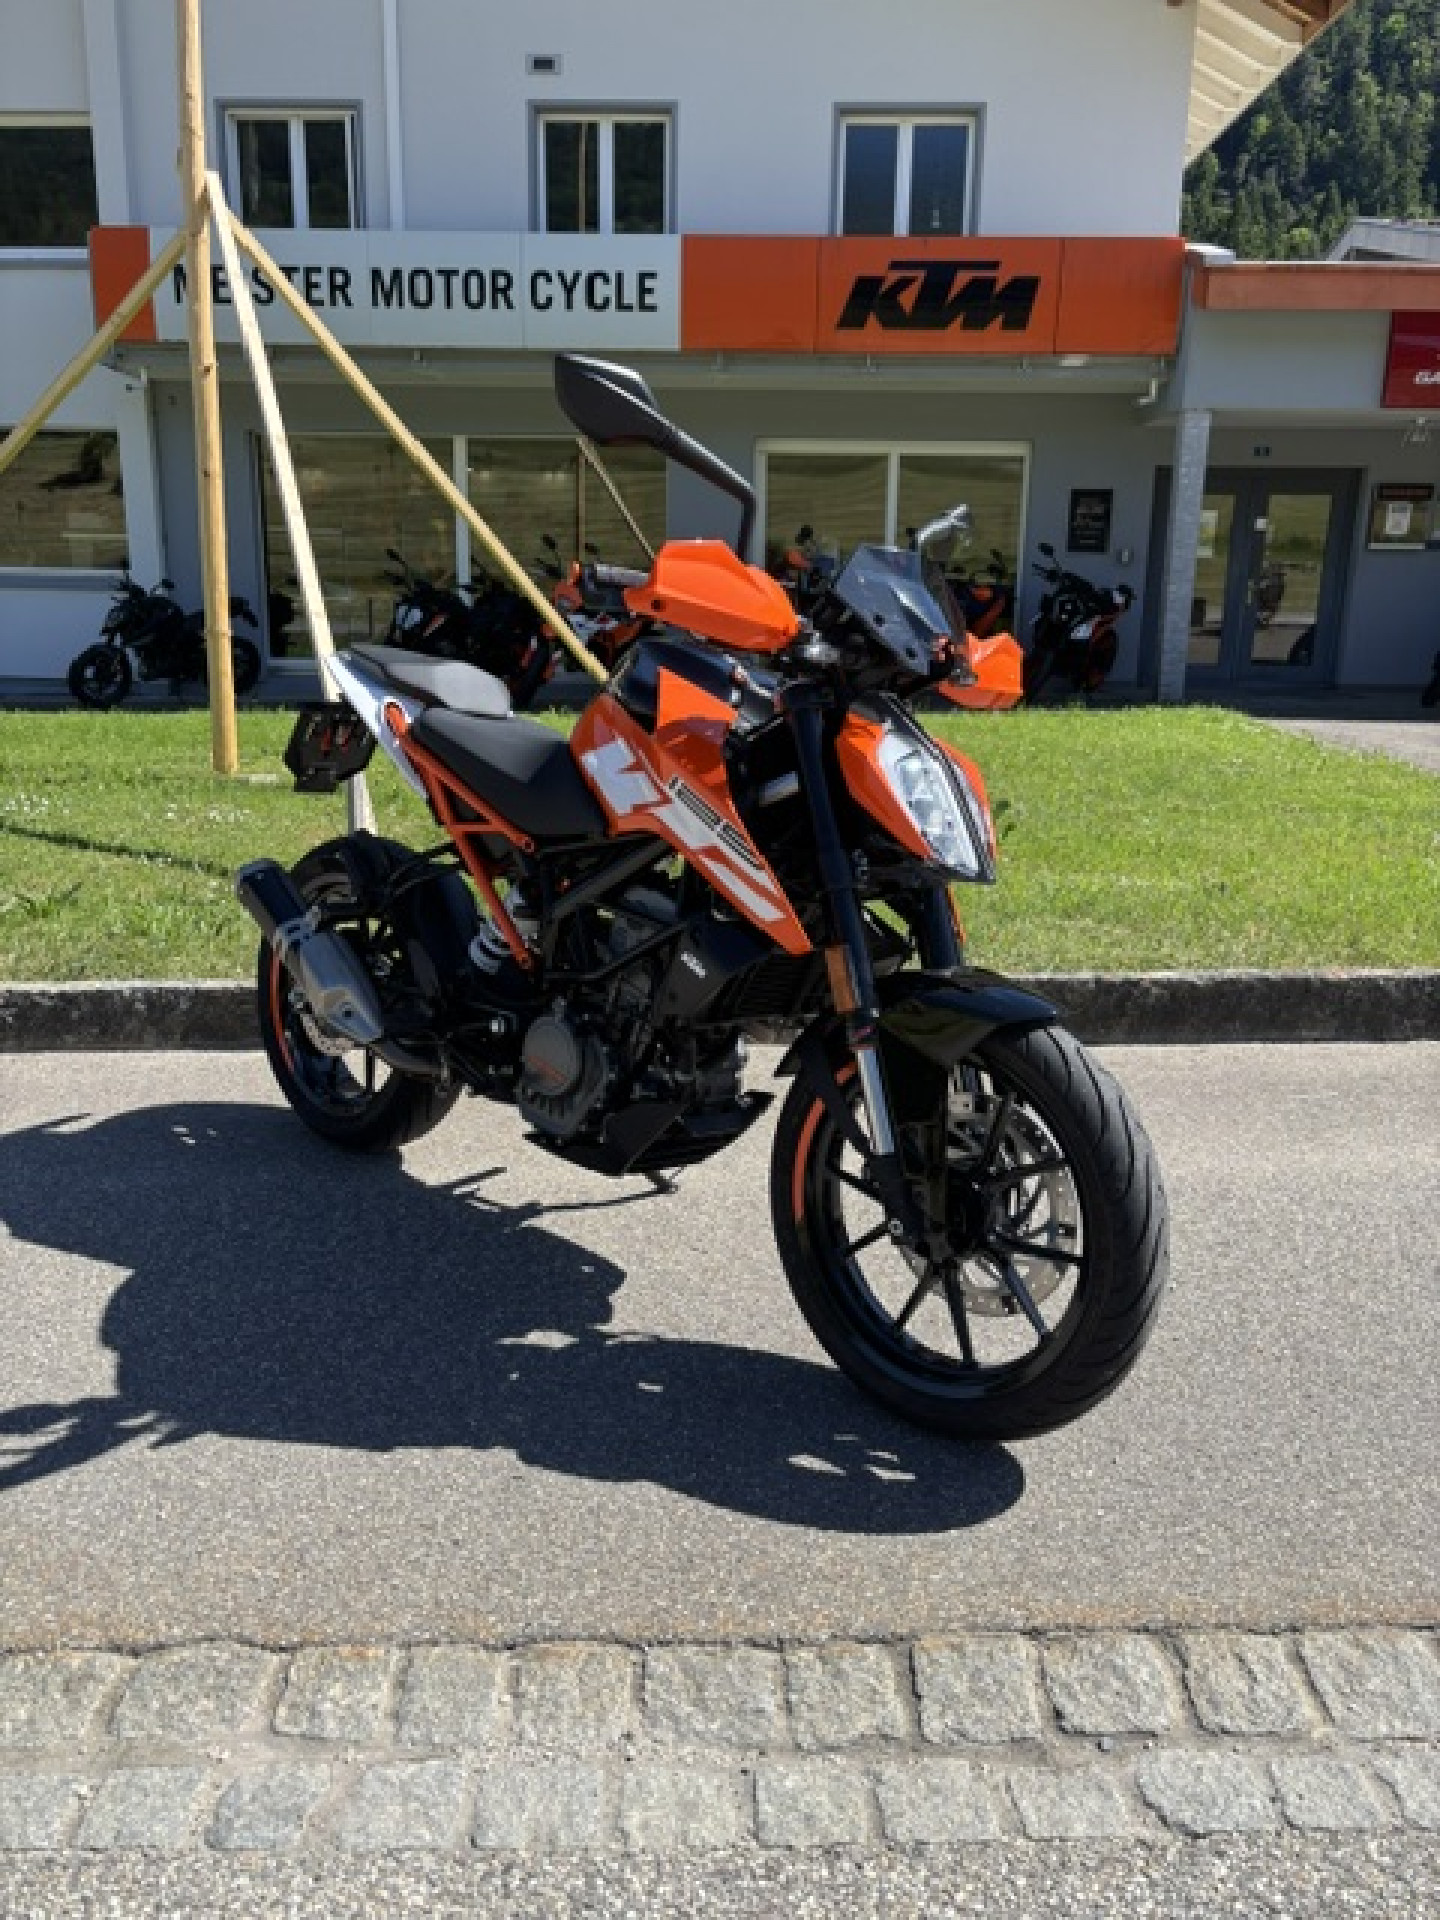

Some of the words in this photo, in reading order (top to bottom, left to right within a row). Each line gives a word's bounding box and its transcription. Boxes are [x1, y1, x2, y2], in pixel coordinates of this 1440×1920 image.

[173, 264, 354, 307] ESTER
[370, 267, 515, 310] MOTOR
[530, 270, 659, 313] CYCLE
[836, 261, 1041, 330] KTM
